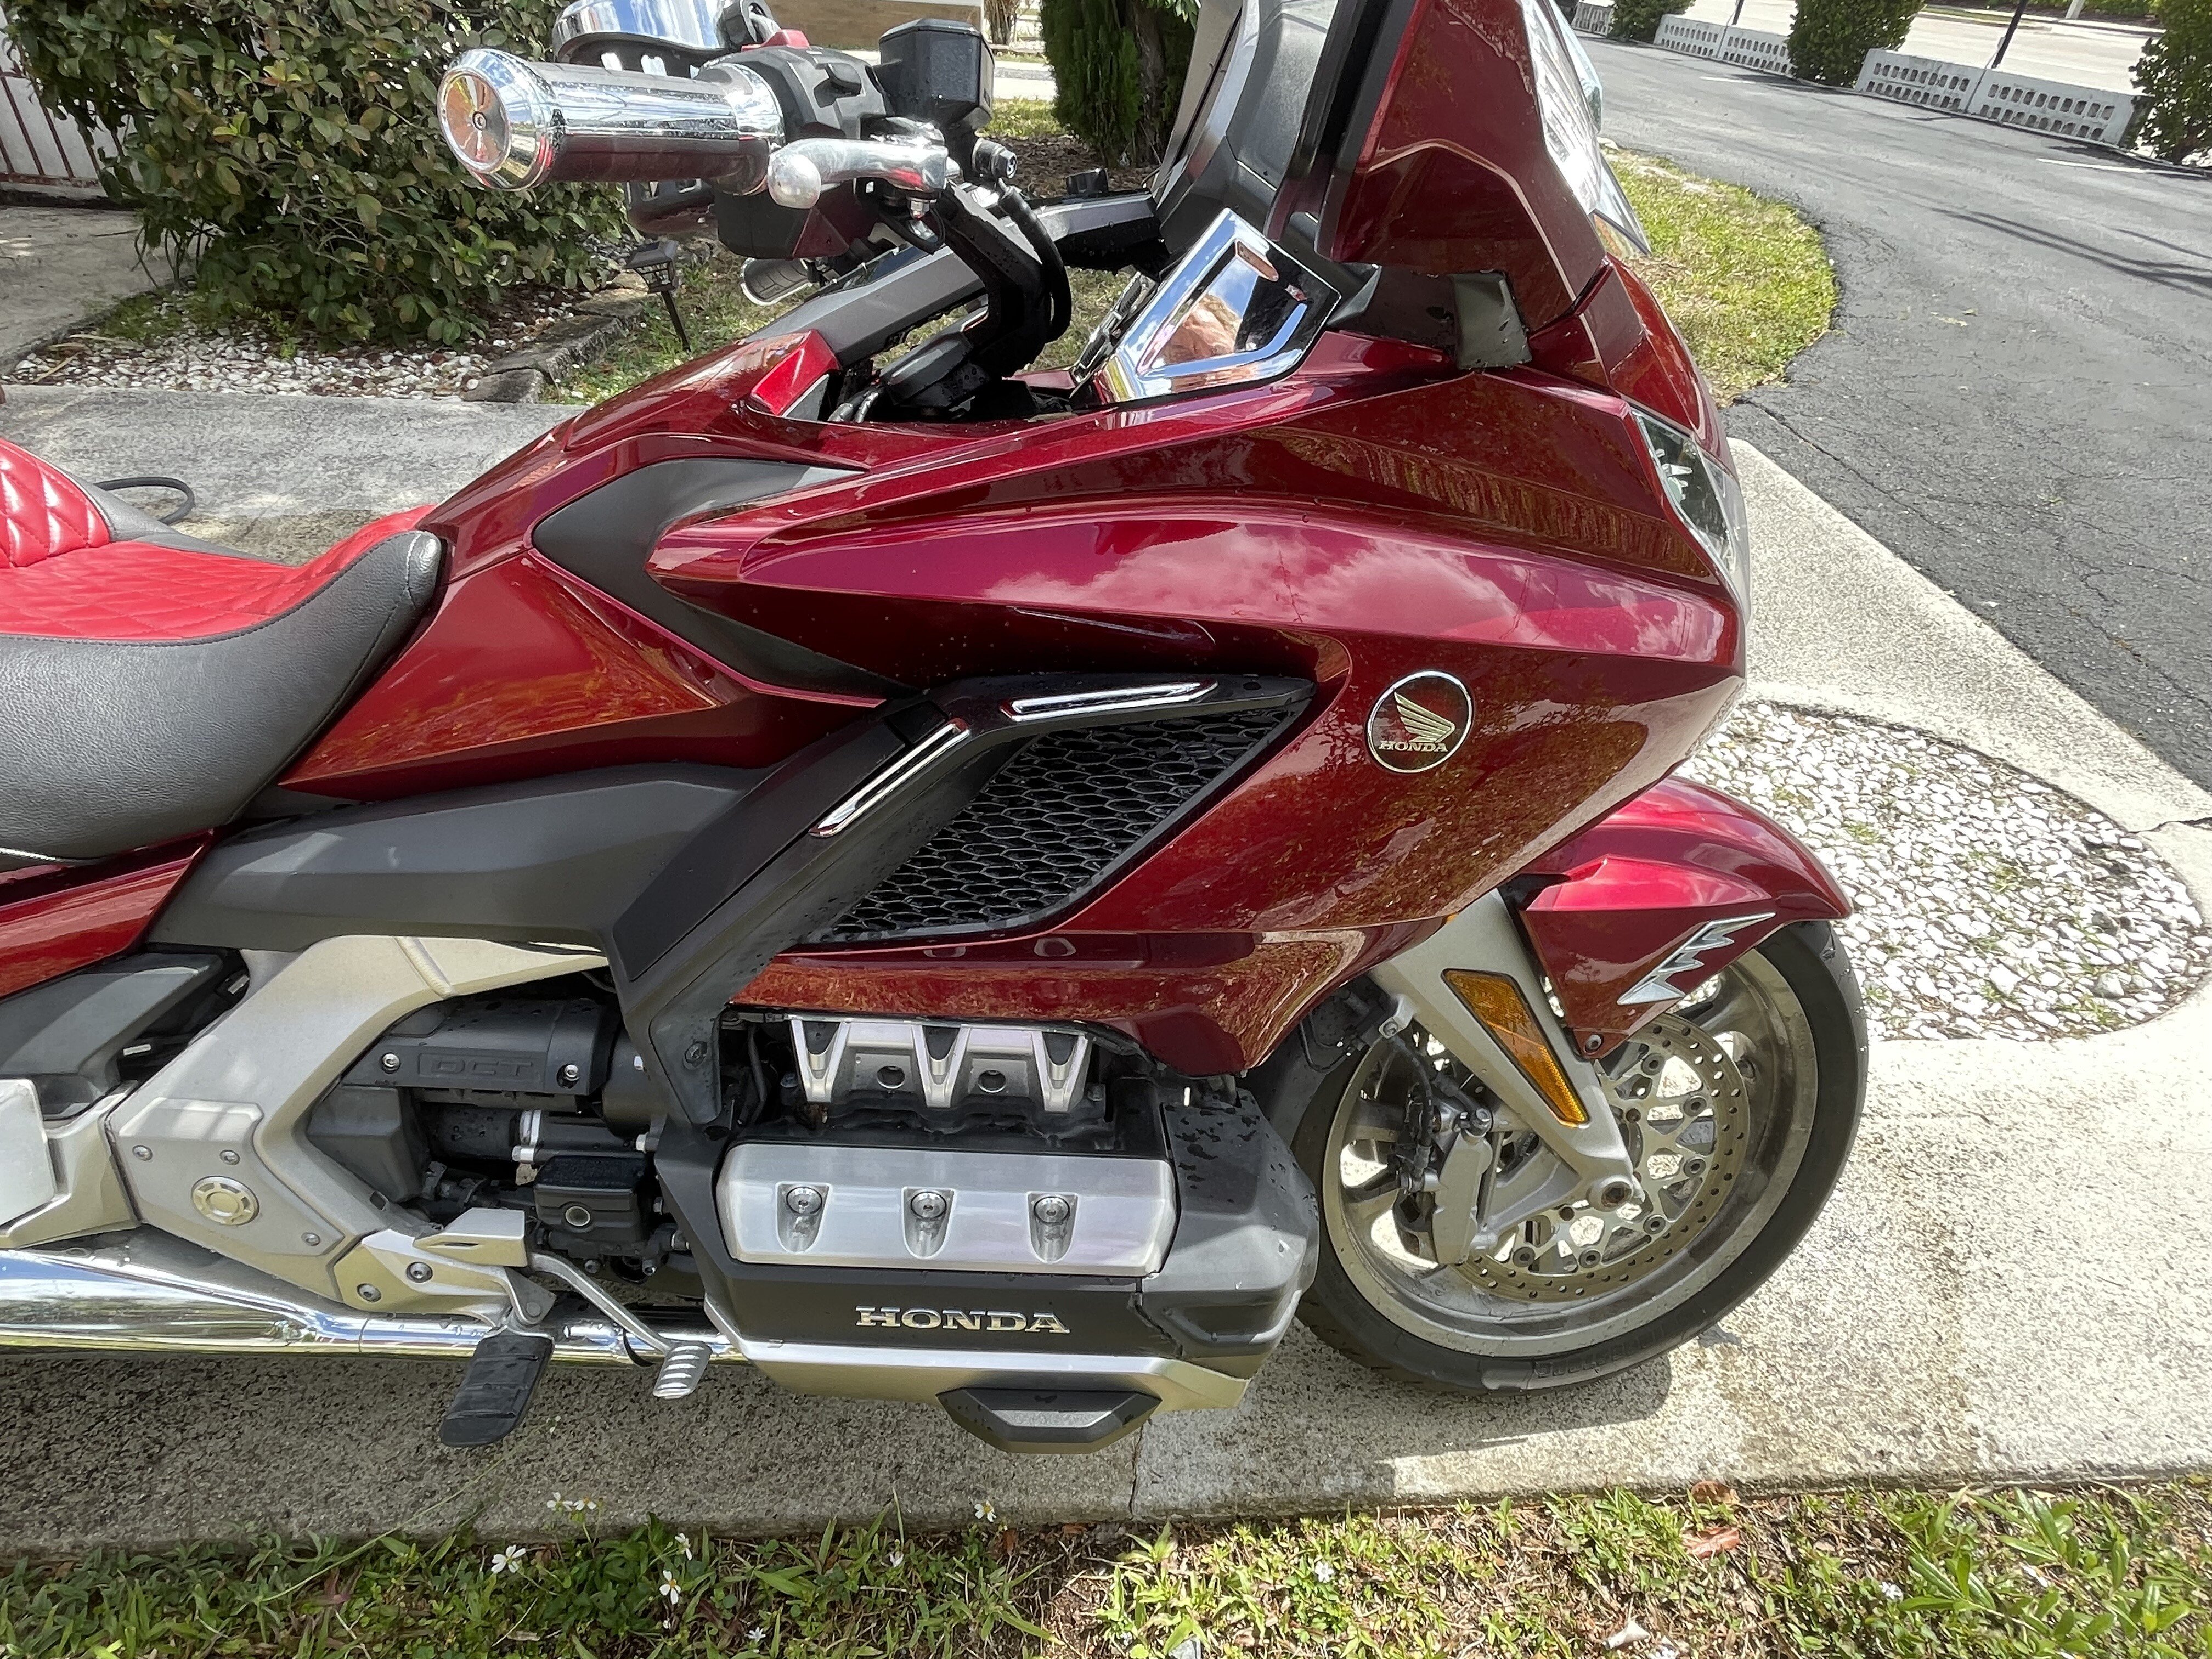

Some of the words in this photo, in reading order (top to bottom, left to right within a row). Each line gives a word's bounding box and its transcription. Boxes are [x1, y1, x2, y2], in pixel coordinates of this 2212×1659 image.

[1378, 741, 1448, 752] HONDA
[431, 1059, 533, 1076] DCT
[855, 1305, 1070, 1333] HONDA
